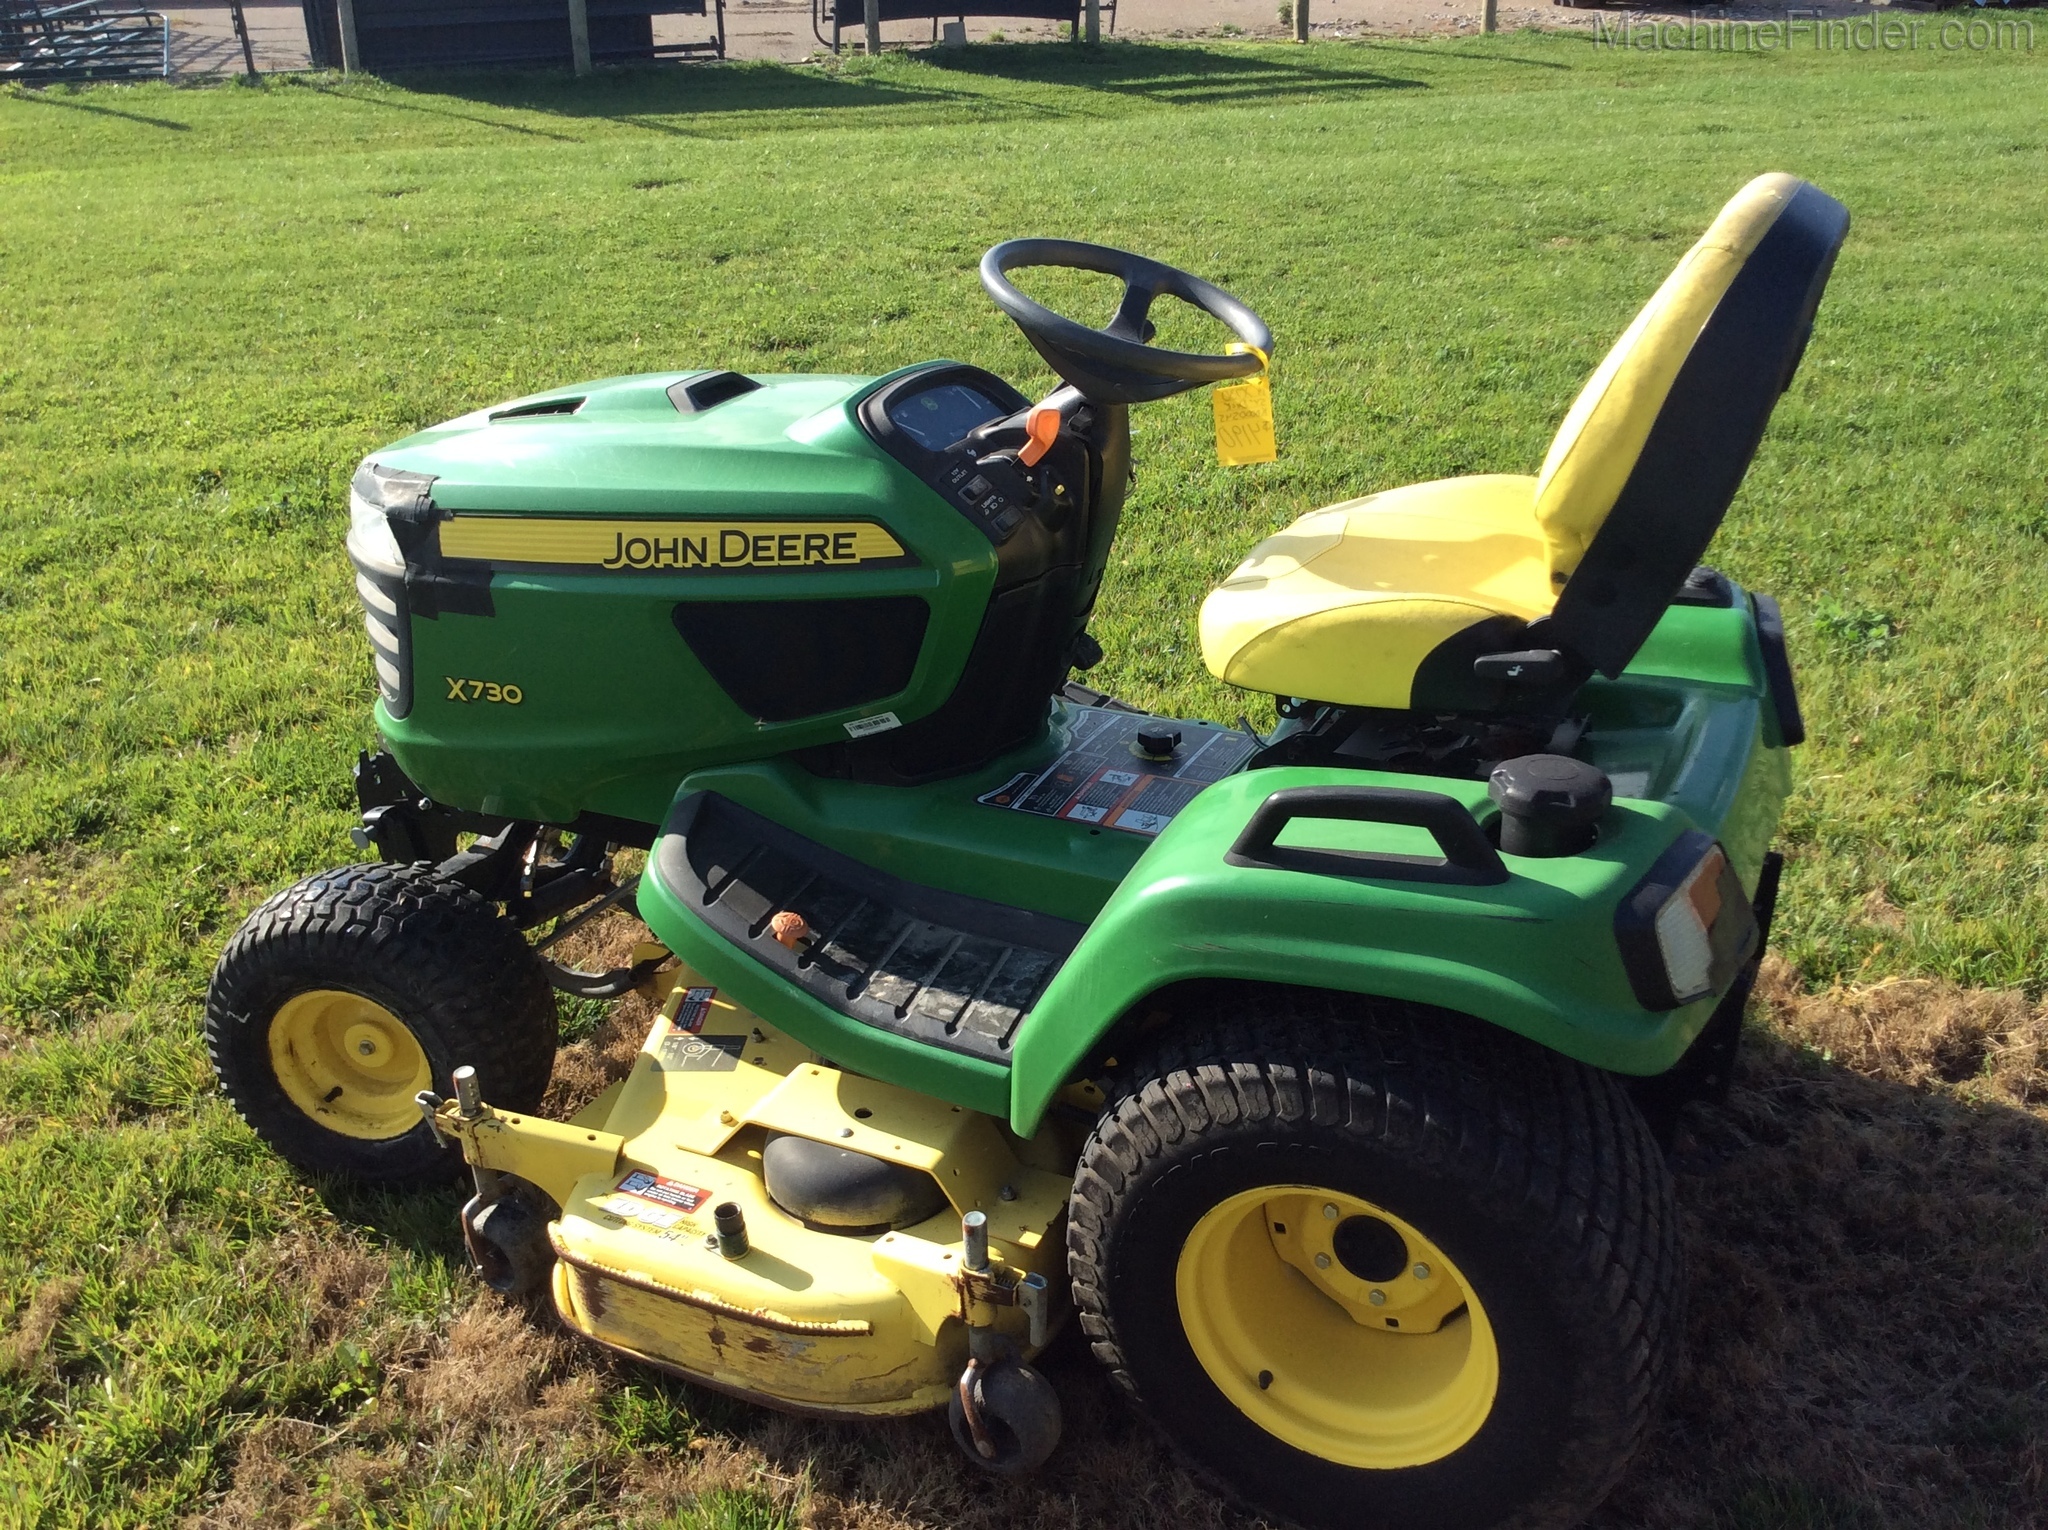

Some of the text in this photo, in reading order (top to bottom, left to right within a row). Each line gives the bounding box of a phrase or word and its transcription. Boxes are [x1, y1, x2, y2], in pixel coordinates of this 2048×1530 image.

[951, 469, 968, 484] OUTLET
[981, 495, 997, 508] LIGHTS
[603, 529, 860, 567] JOHN DEERE
[445, 676, 523, 704] X730
